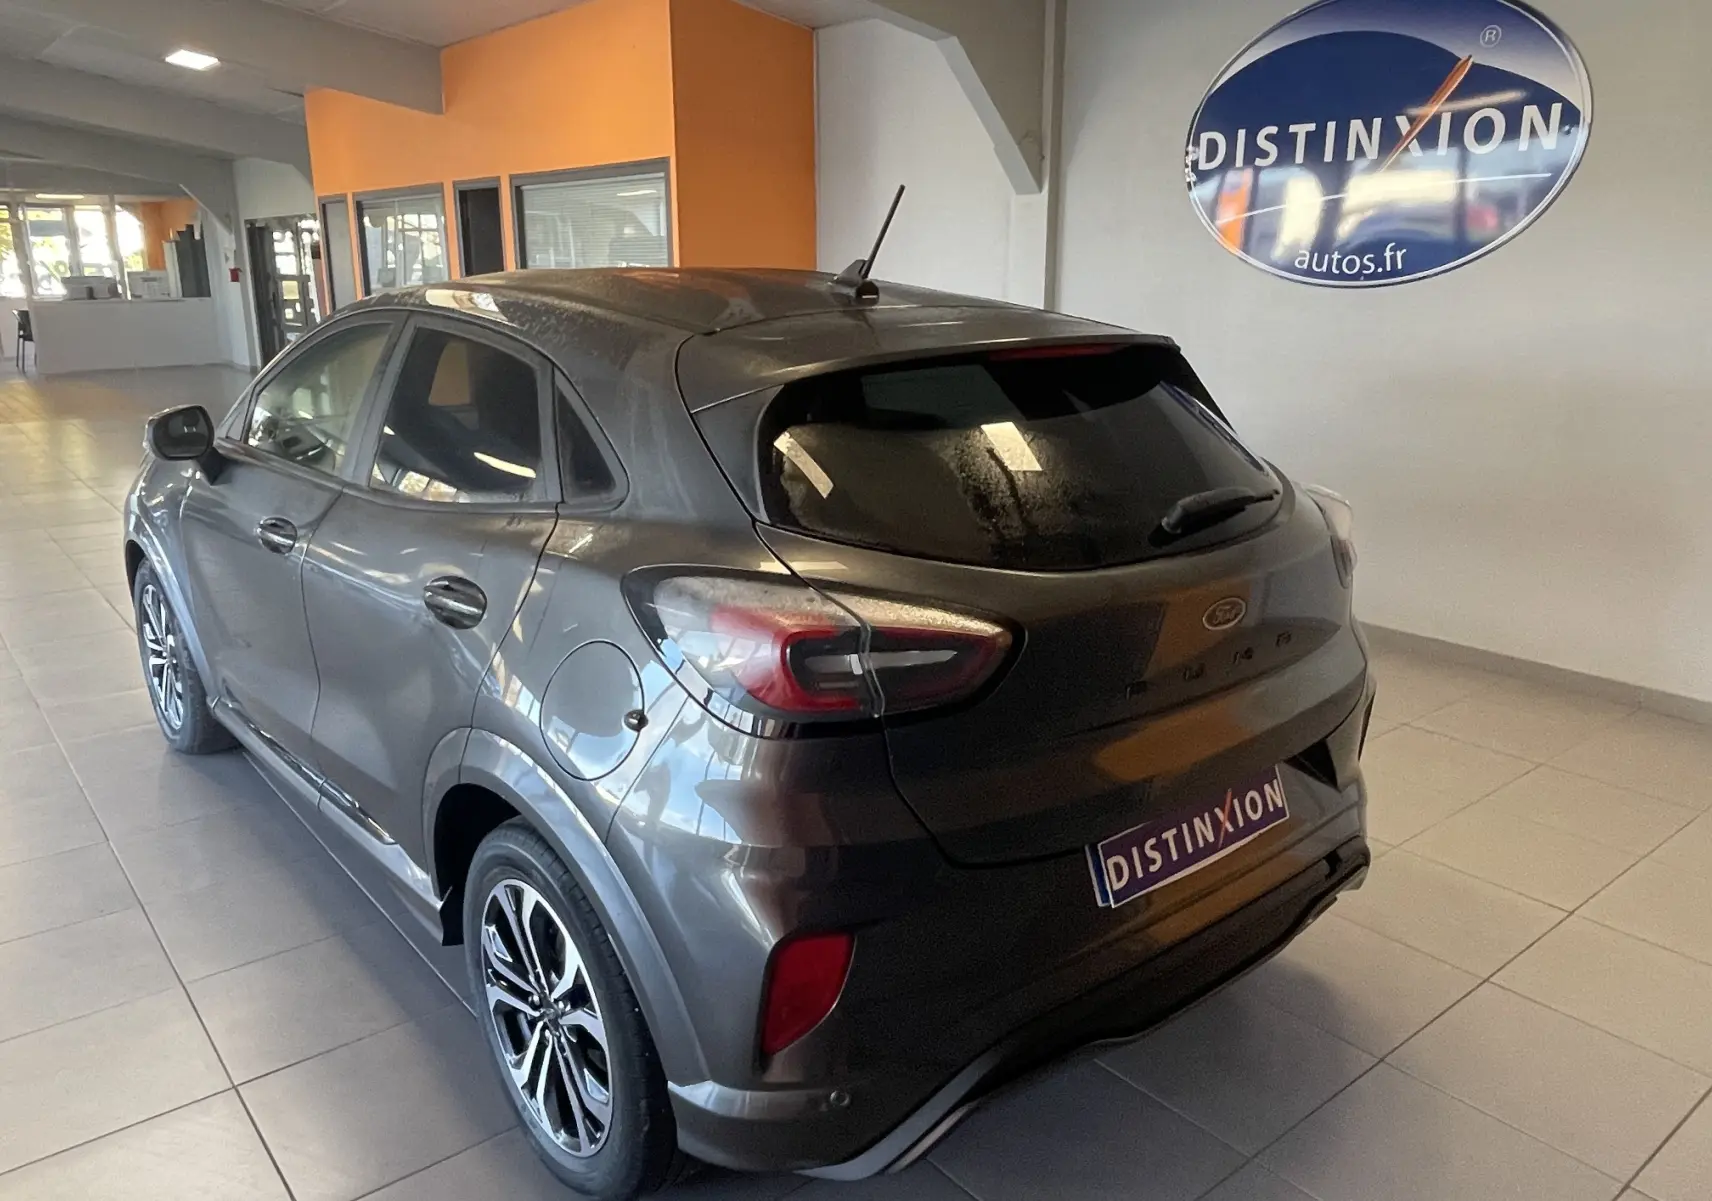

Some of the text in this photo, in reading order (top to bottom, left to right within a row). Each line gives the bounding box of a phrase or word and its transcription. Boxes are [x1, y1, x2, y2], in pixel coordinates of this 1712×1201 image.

[1197, 102, 1563, 171] DISTINXION
[1294, 242, 1408, 276] autos.fr
[1106, 779, 1284, 892] DISTINXION
